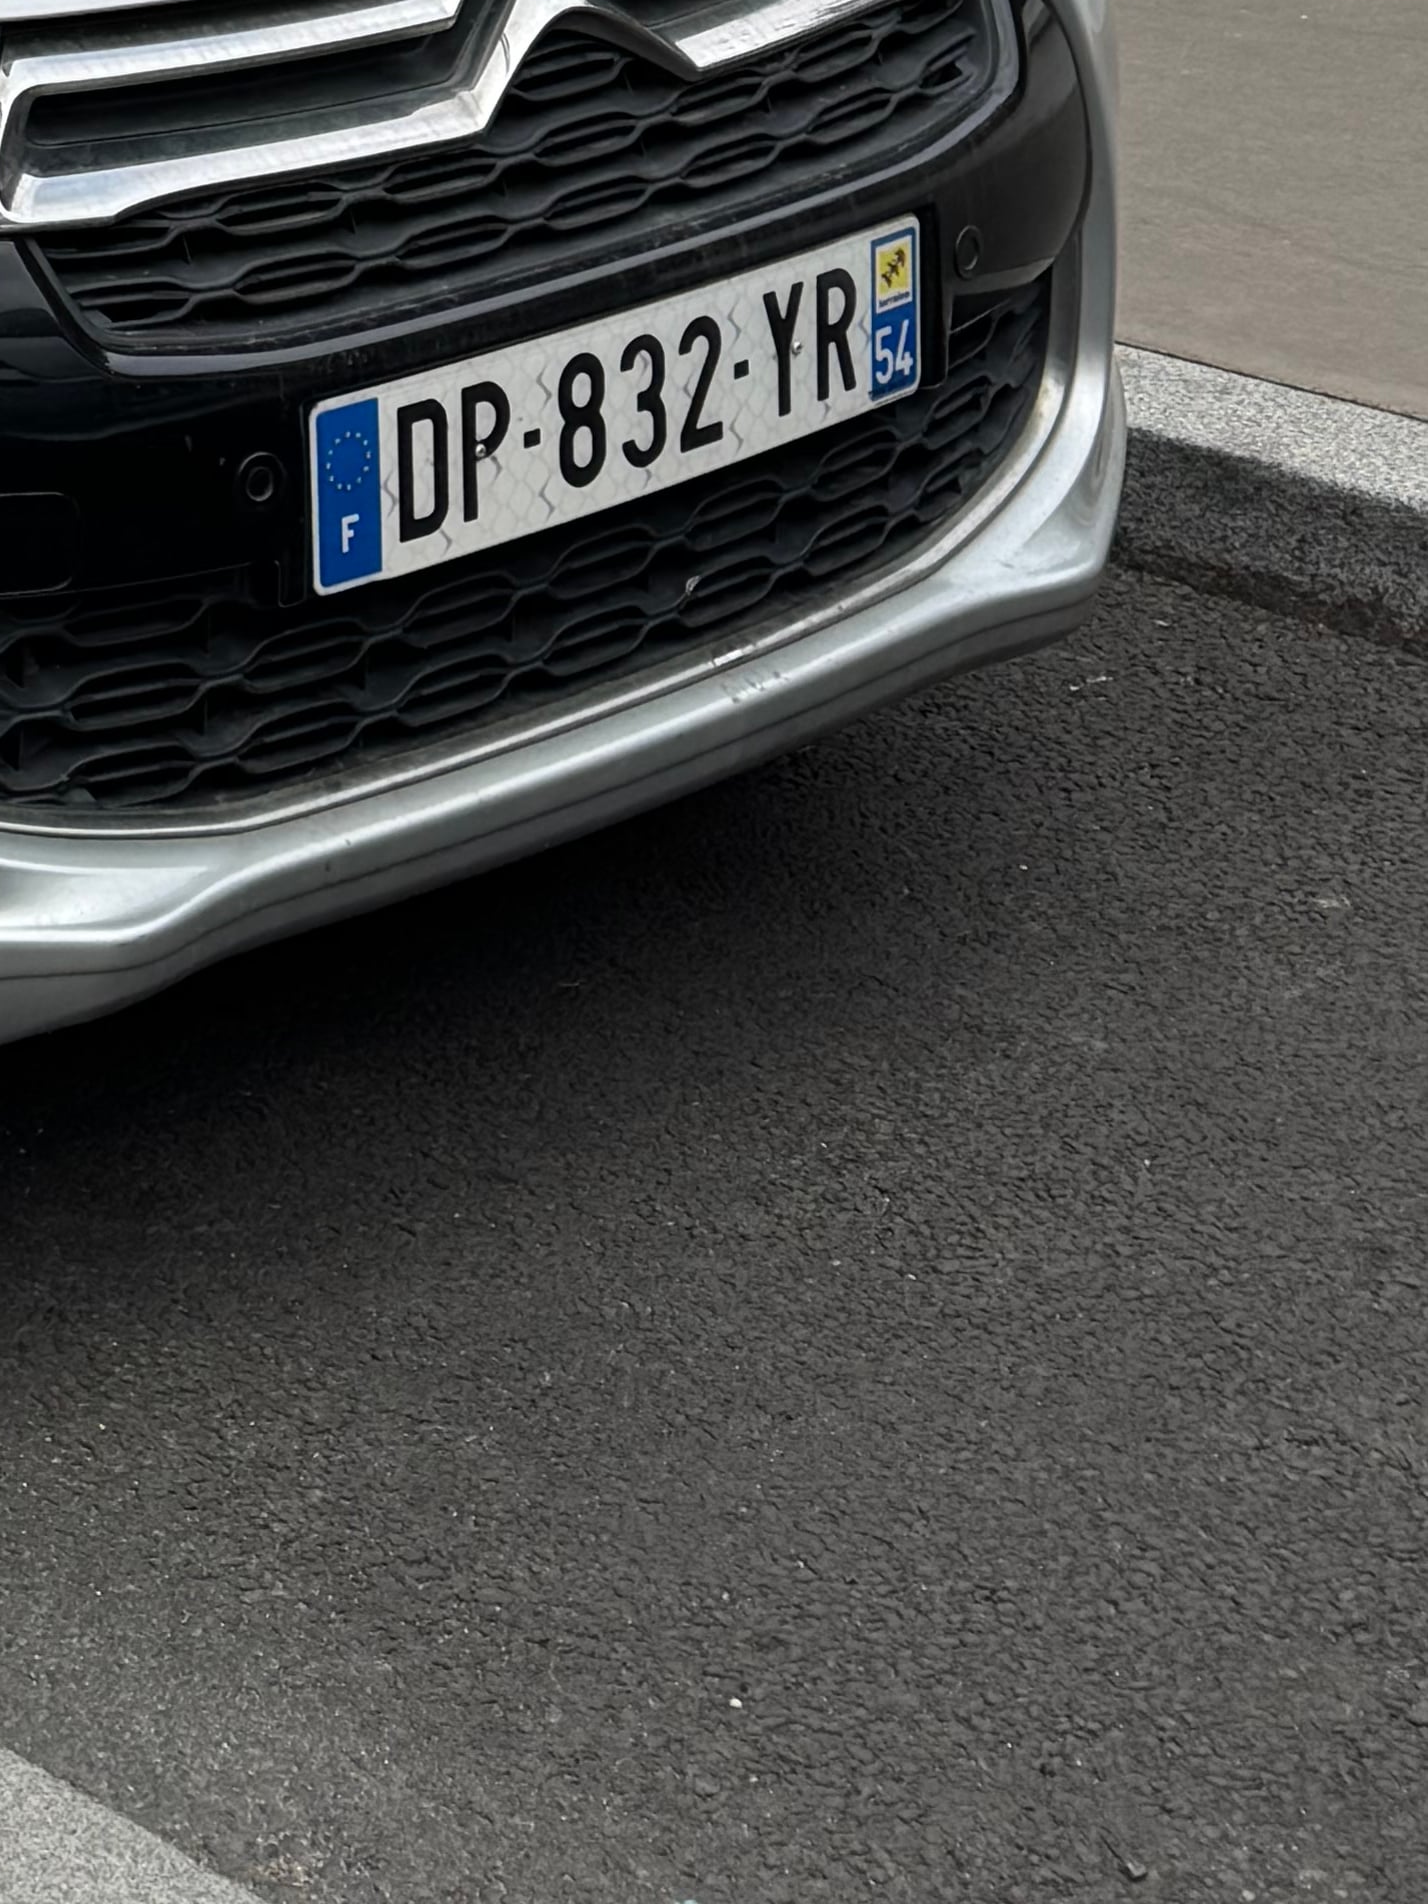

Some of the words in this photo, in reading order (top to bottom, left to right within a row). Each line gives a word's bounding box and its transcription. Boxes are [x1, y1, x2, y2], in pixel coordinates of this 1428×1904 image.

[875, 318, 914, 385] 54
[396, 266, 858, 543] DP-832-YR
[340, 513, 359, 554] F
